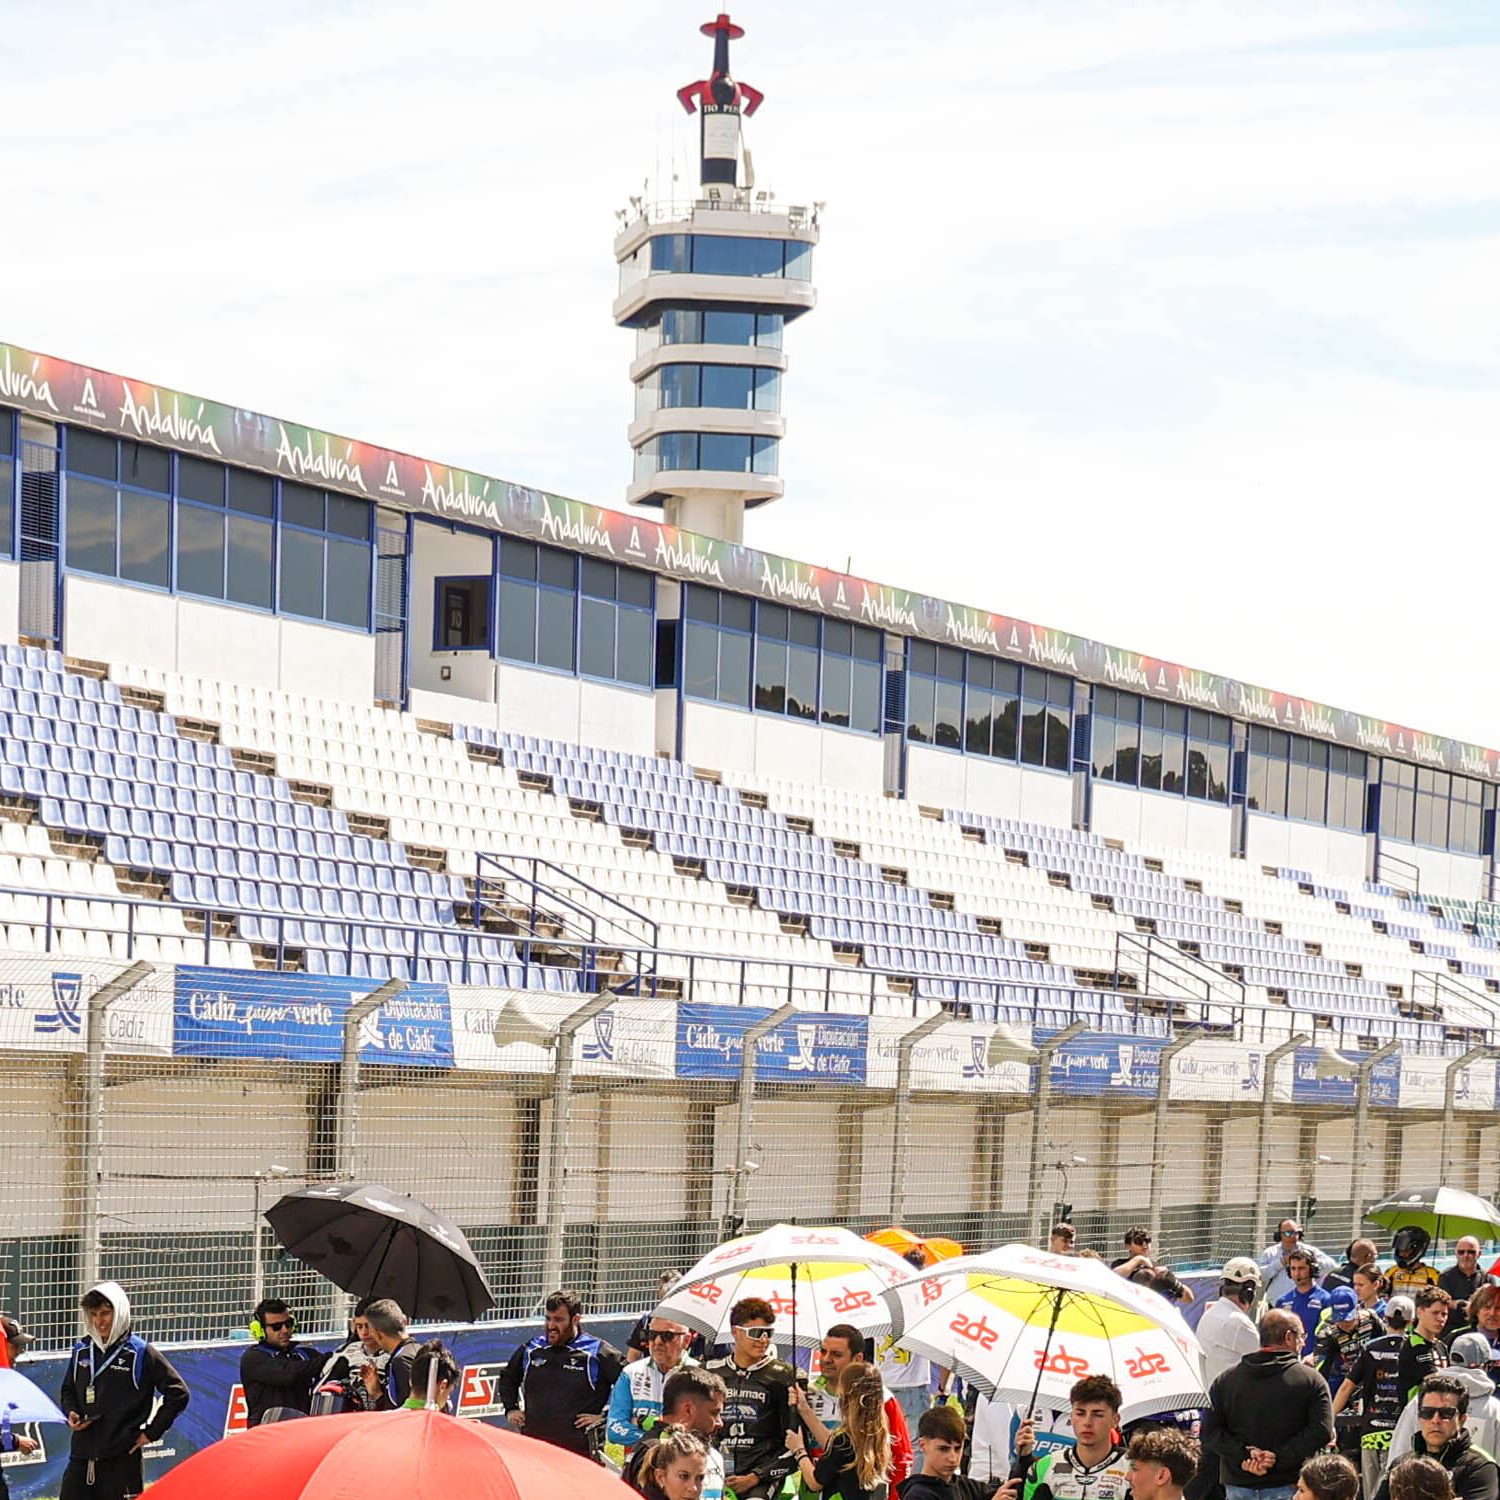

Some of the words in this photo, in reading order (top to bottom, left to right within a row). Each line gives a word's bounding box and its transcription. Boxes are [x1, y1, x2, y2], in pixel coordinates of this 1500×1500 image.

[120, 382, 222, 454] Andalucía
[276, 424, 367, 491] Andalucía
[422, 464, 503, 527] Andalucía
[541, 496, 614, 554] Andalucía
[655, 527, 723, 582] Andalucía
[761, 556, 824, 608] Andalucía
[861, 584, 918, 632] Andalucía
[946, 606, 999, 651] Andalucía
[109, 1014, 145, 1039] Cádiz
[190, 991, 238, 1021] Cádiz
[295, 1002, 334, 1026] verte
[463, 1010, 498, 1034] Cádi
[388, 1029, 403, 1044] de
[405, 1026, 437, 1051] Cádiz
[686, 1025, 720, 1050] Cádiz
[725, 1387, 767, 1403] Blumaq
